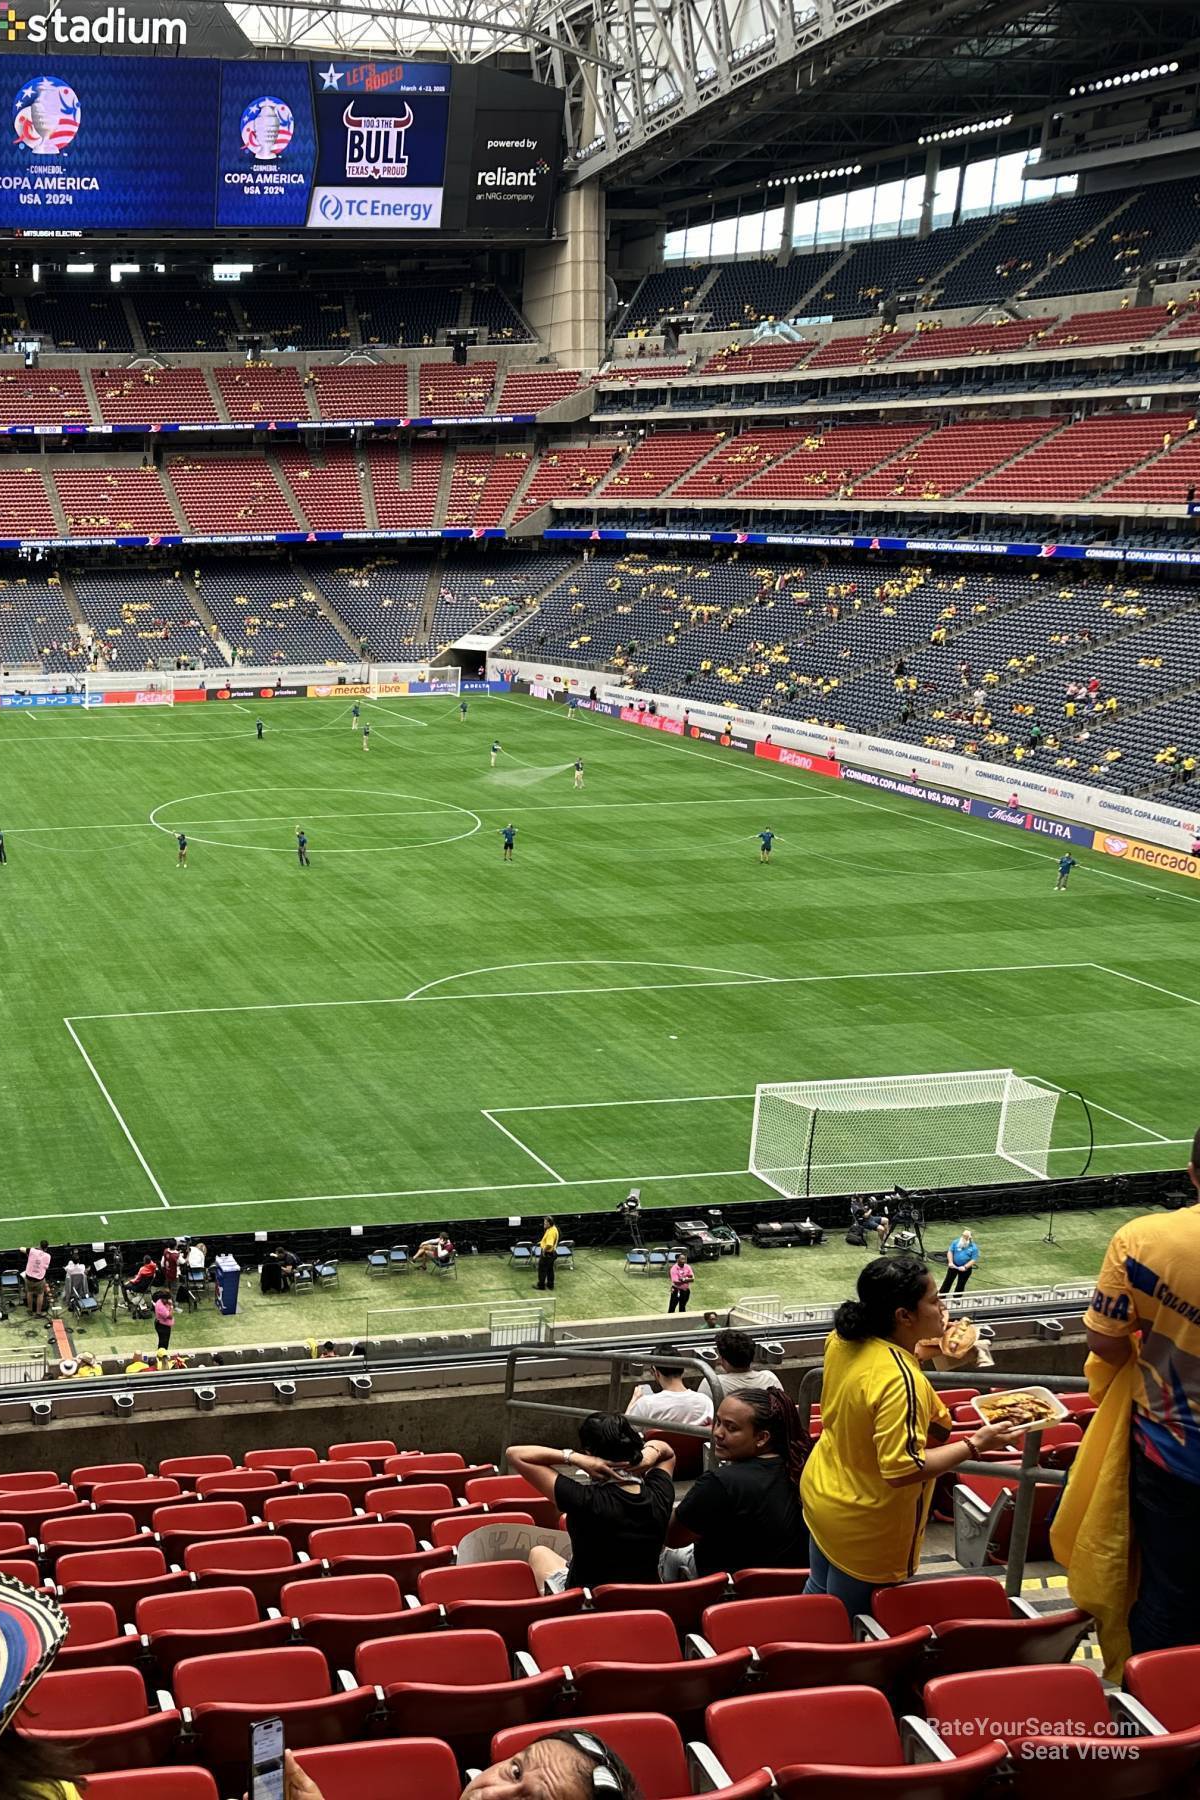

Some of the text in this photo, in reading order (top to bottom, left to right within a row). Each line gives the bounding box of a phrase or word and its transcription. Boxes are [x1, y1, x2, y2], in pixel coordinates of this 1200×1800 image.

[27, 7, 186, 44] stadium
[366, 64, 403, 91] RODEO
[381, 120, 392, 128] THE
[348, 131, 406, 163] BULL
[488, 138, 537, 150] powered by
[224, 173, 305, 184] COPA AMERICA
[348, 166, 406, 175] TEXAS PROUD
[477, 167, 536, 186] reliant
[34, 178, 99, 190] AMERICA
[244, 186, 284, 195] USA 2024
[19, 194, 73, 205] USA 2024
[486, 192, 502, 200] NRG
[503, 194, 534, 202] company
[345, 200, 432, 220] TC Energy
[779, 749, 812, 768] Betano
[846, 769, 960, 807] CONMEBOL COPA AMERICA USA 2024
[1006, 778, 1021, 786] COPA
[988, 807, 1071, 839] Michelob ULTRA
[1099, 800, 1195, 831] CONMEBOL COPA AMERICA USA
[1132, 846, 1197, 873] mercado
